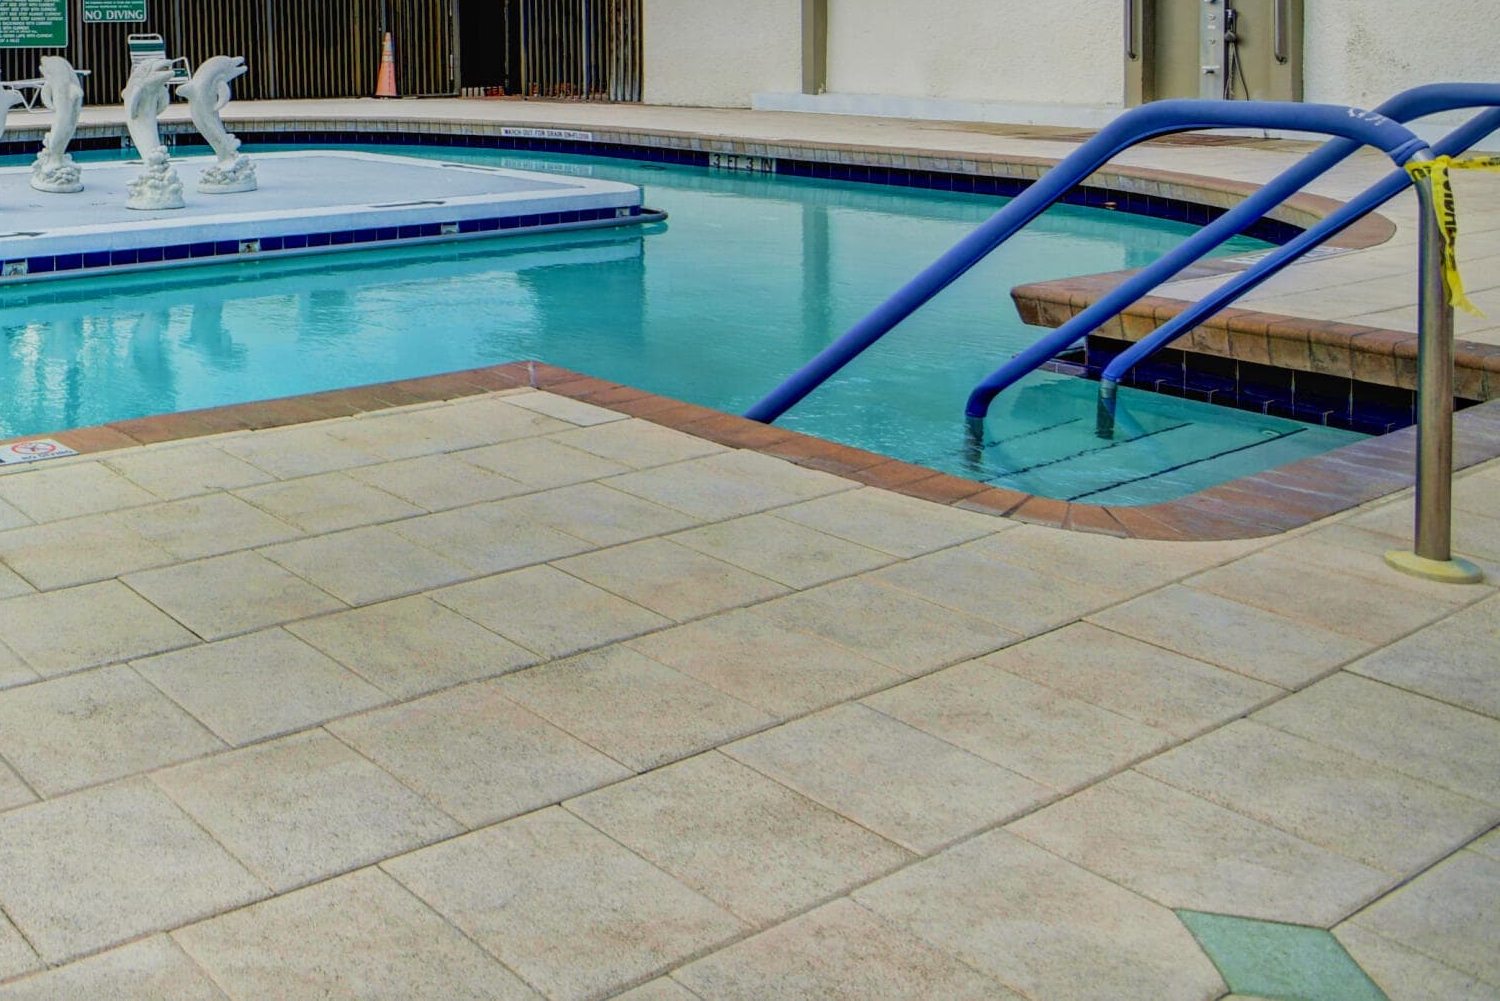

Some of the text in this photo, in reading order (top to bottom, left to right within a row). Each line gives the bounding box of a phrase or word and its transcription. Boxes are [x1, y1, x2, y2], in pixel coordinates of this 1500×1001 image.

[86, 10, 144, 20] NO DIVING
[713, 153, 772, 173] 3 FT 3 IN
